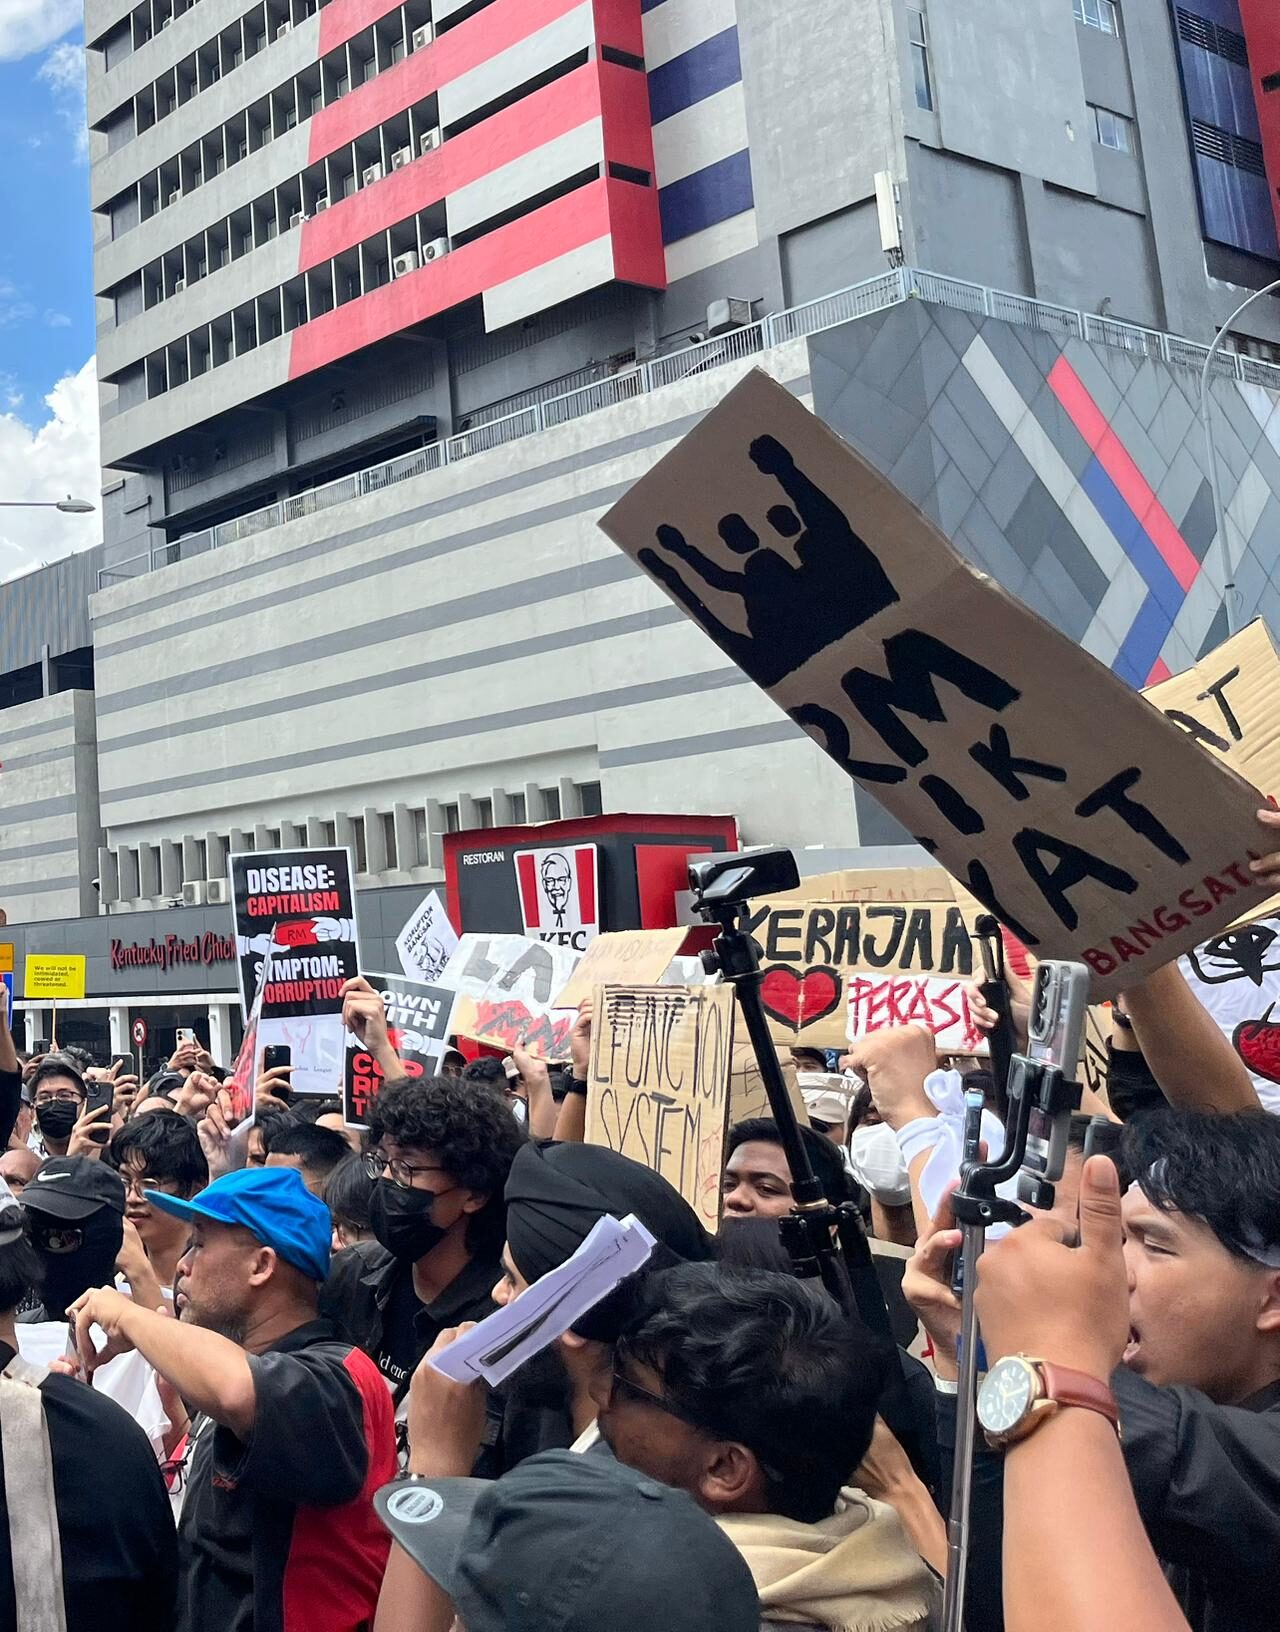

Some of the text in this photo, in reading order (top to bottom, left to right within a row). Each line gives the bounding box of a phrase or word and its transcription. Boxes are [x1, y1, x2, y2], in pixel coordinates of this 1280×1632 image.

[463, 851, 505, 865] RESTORAN
[246, 864, 336, 894] DISEASE:
[246, 891, 340, 917] CAPITALISM
[287, 929, 307, 942] RM
[111, 937, 167, 972] Kentucky
[165, 932, 201, 966] Fried
[372, 989, 441, 1014] OWN
[383, 1005, 436, 1030] ITH
